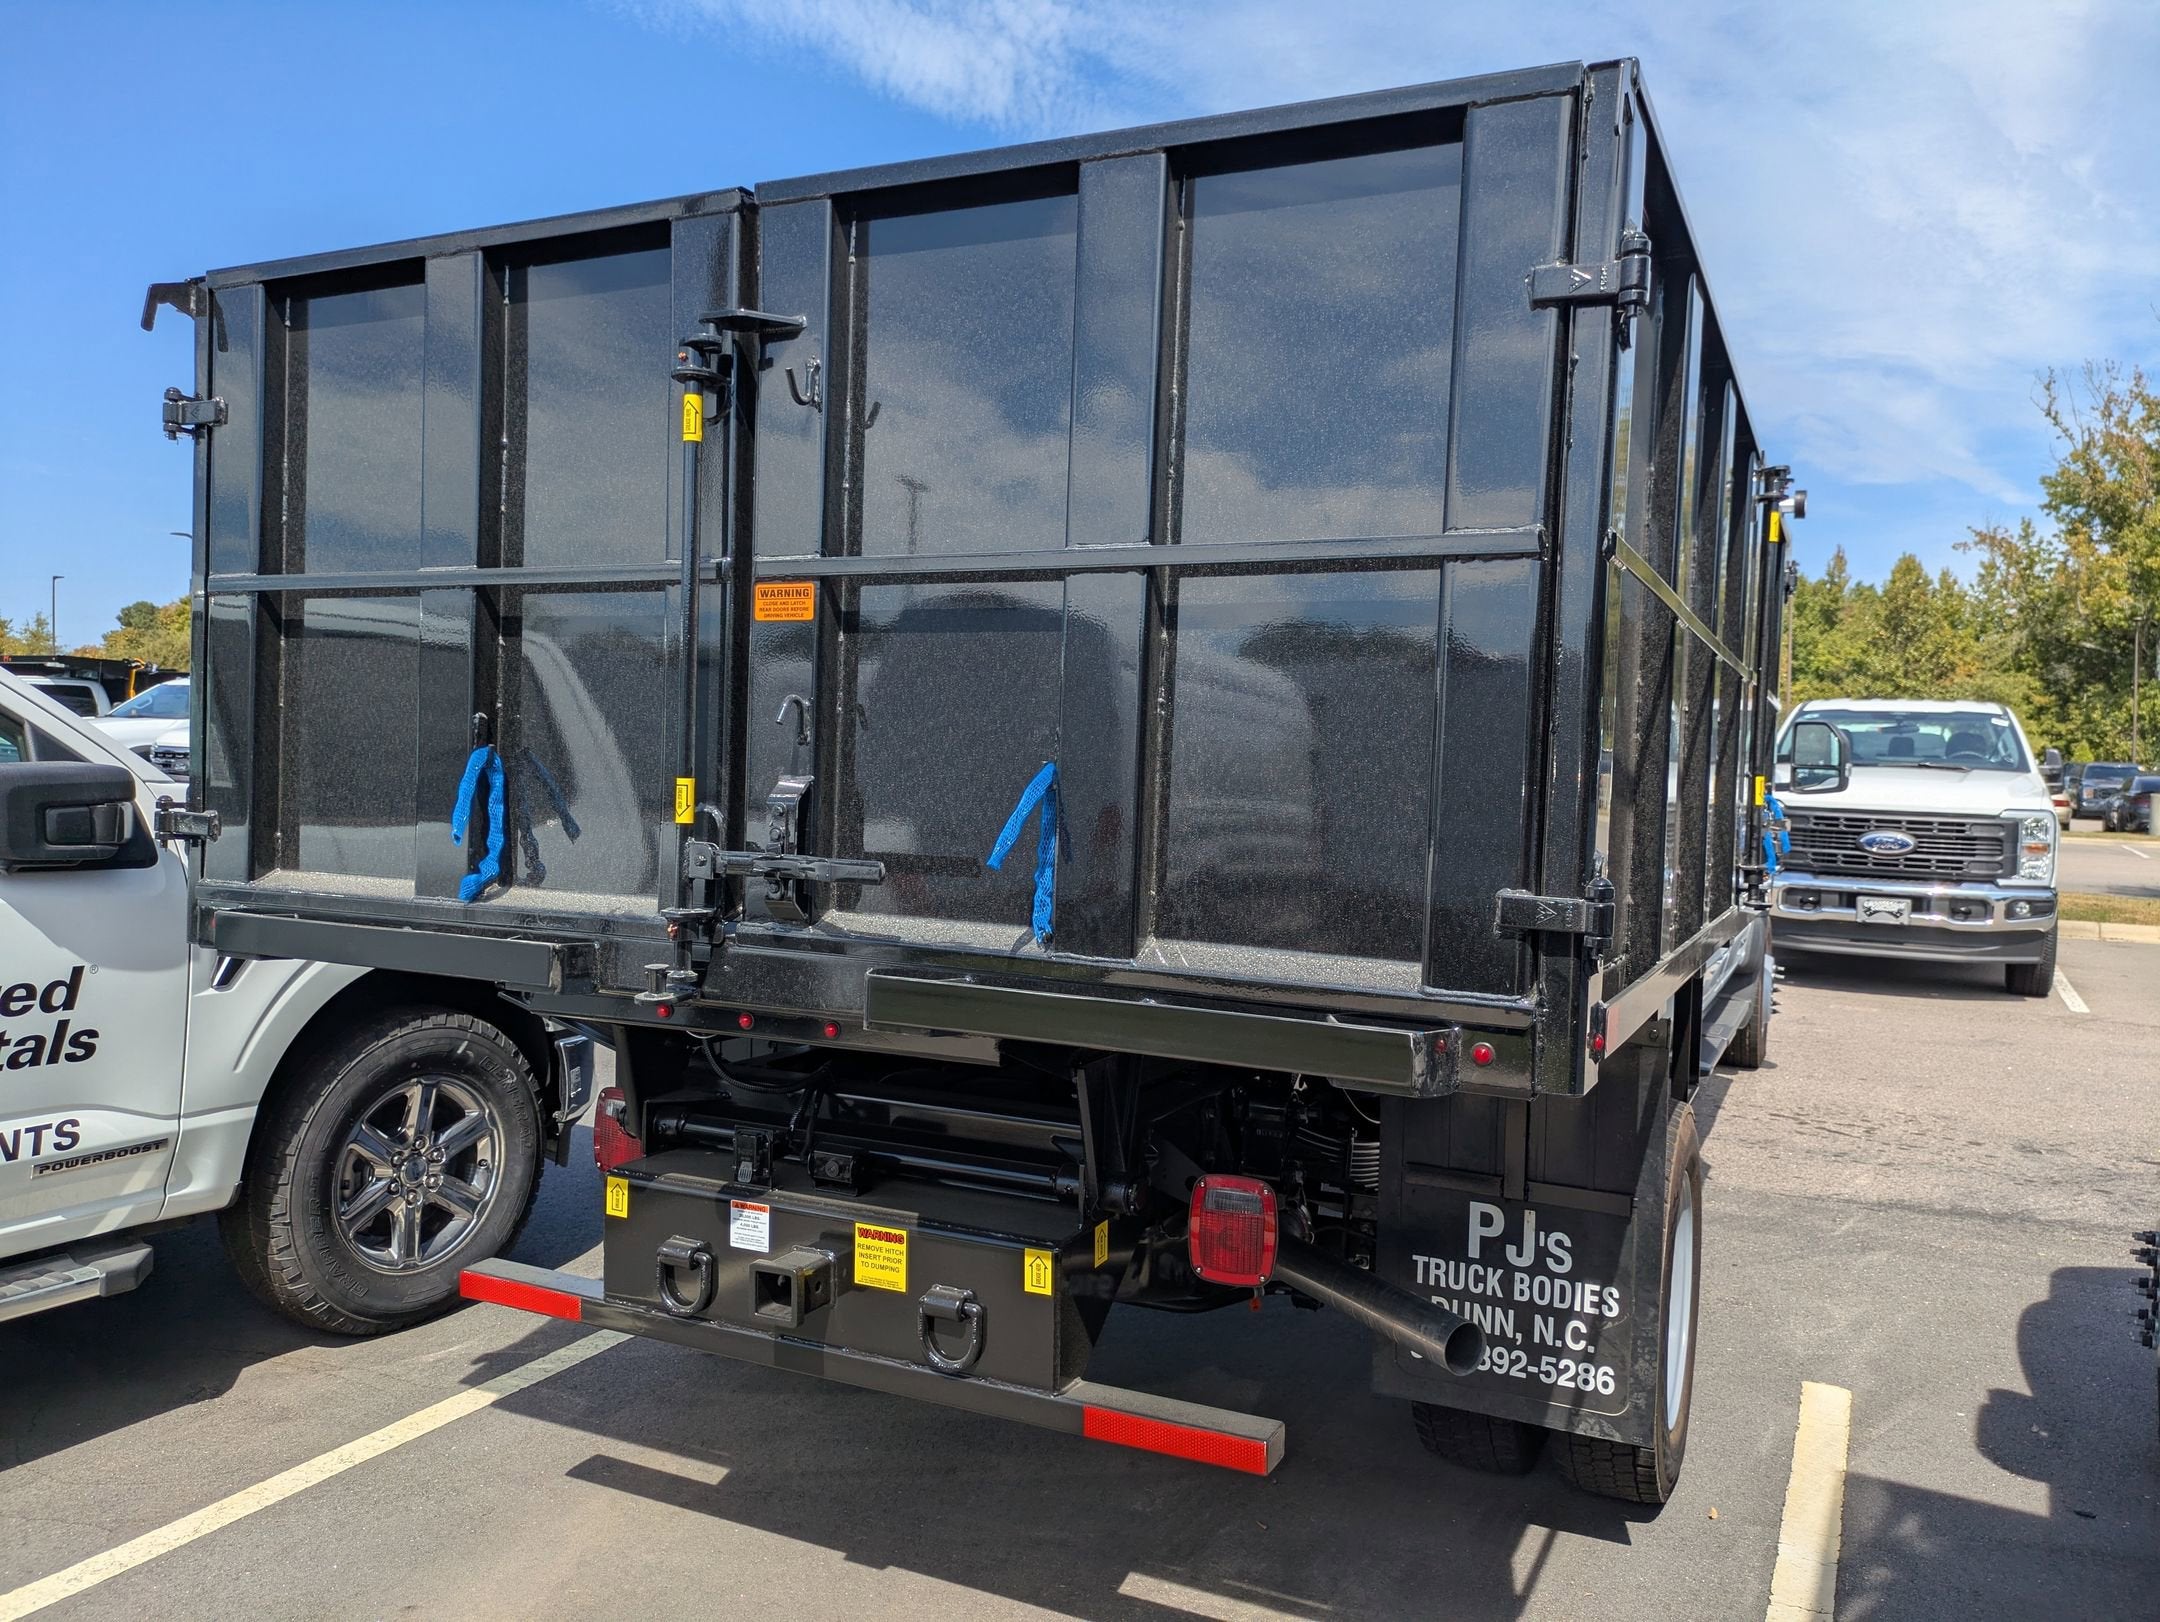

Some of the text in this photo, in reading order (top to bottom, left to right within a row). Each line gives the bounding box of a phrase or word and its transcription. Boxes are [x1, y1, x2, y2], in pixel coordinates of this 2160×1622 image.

[760, 588, 809, 598] WARNING
[0, 965, 85, 1017] ed
[39, 1140, 163, 1174] POWERBOOST
[740, 1203, 766, 1213] WARNING
[857, 1226, 904, 1245] WARNING
[1468, 1201, 1573, 1273] PJ'S
[857, 1243, 904, 1256] REMOVE HITCH
[859, 1251, 902, 1264] INSERT PRIOR
[861, 1260, 900, 1273] TO DUMPING
[1412, 1254, 1620, 1318] TRUCK BODIES
[1533, 1313, 1595, 1354] N.C.
